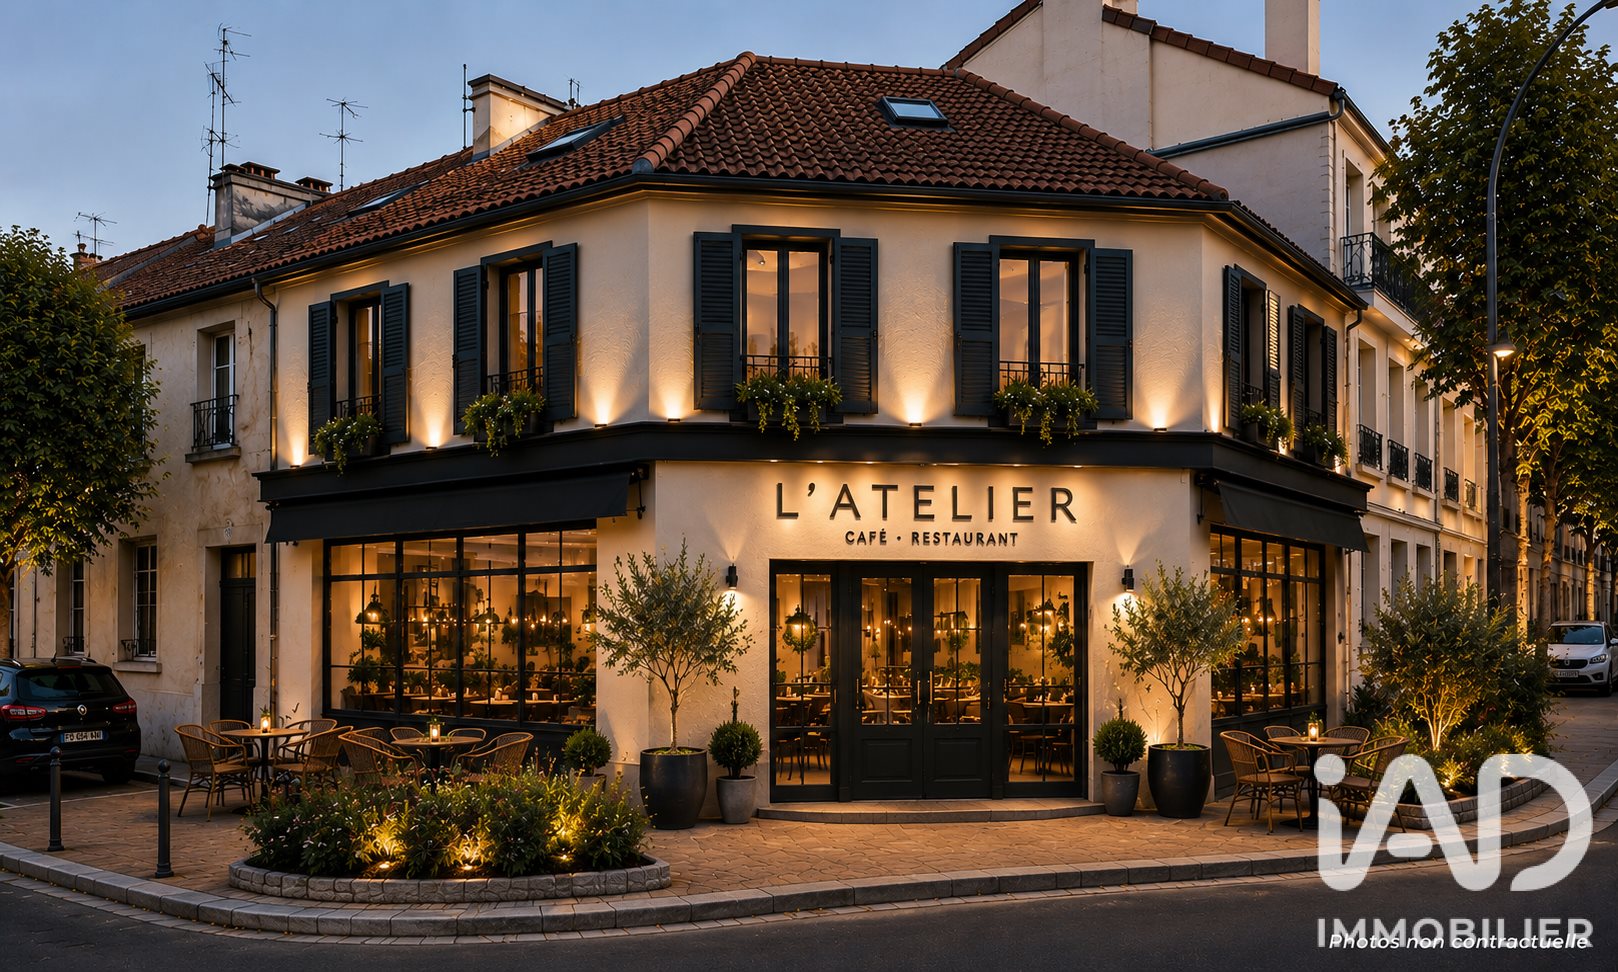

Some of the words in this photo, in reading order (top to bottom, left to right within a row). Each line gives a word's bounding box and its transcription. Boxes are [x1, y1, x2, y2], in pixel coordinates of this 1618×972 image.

[776, 483, 1077, 522] L'ATELIER
[845, 528, 887, 545] CAFÉ
[911, 531, 1019, 546] RESTAURANT
